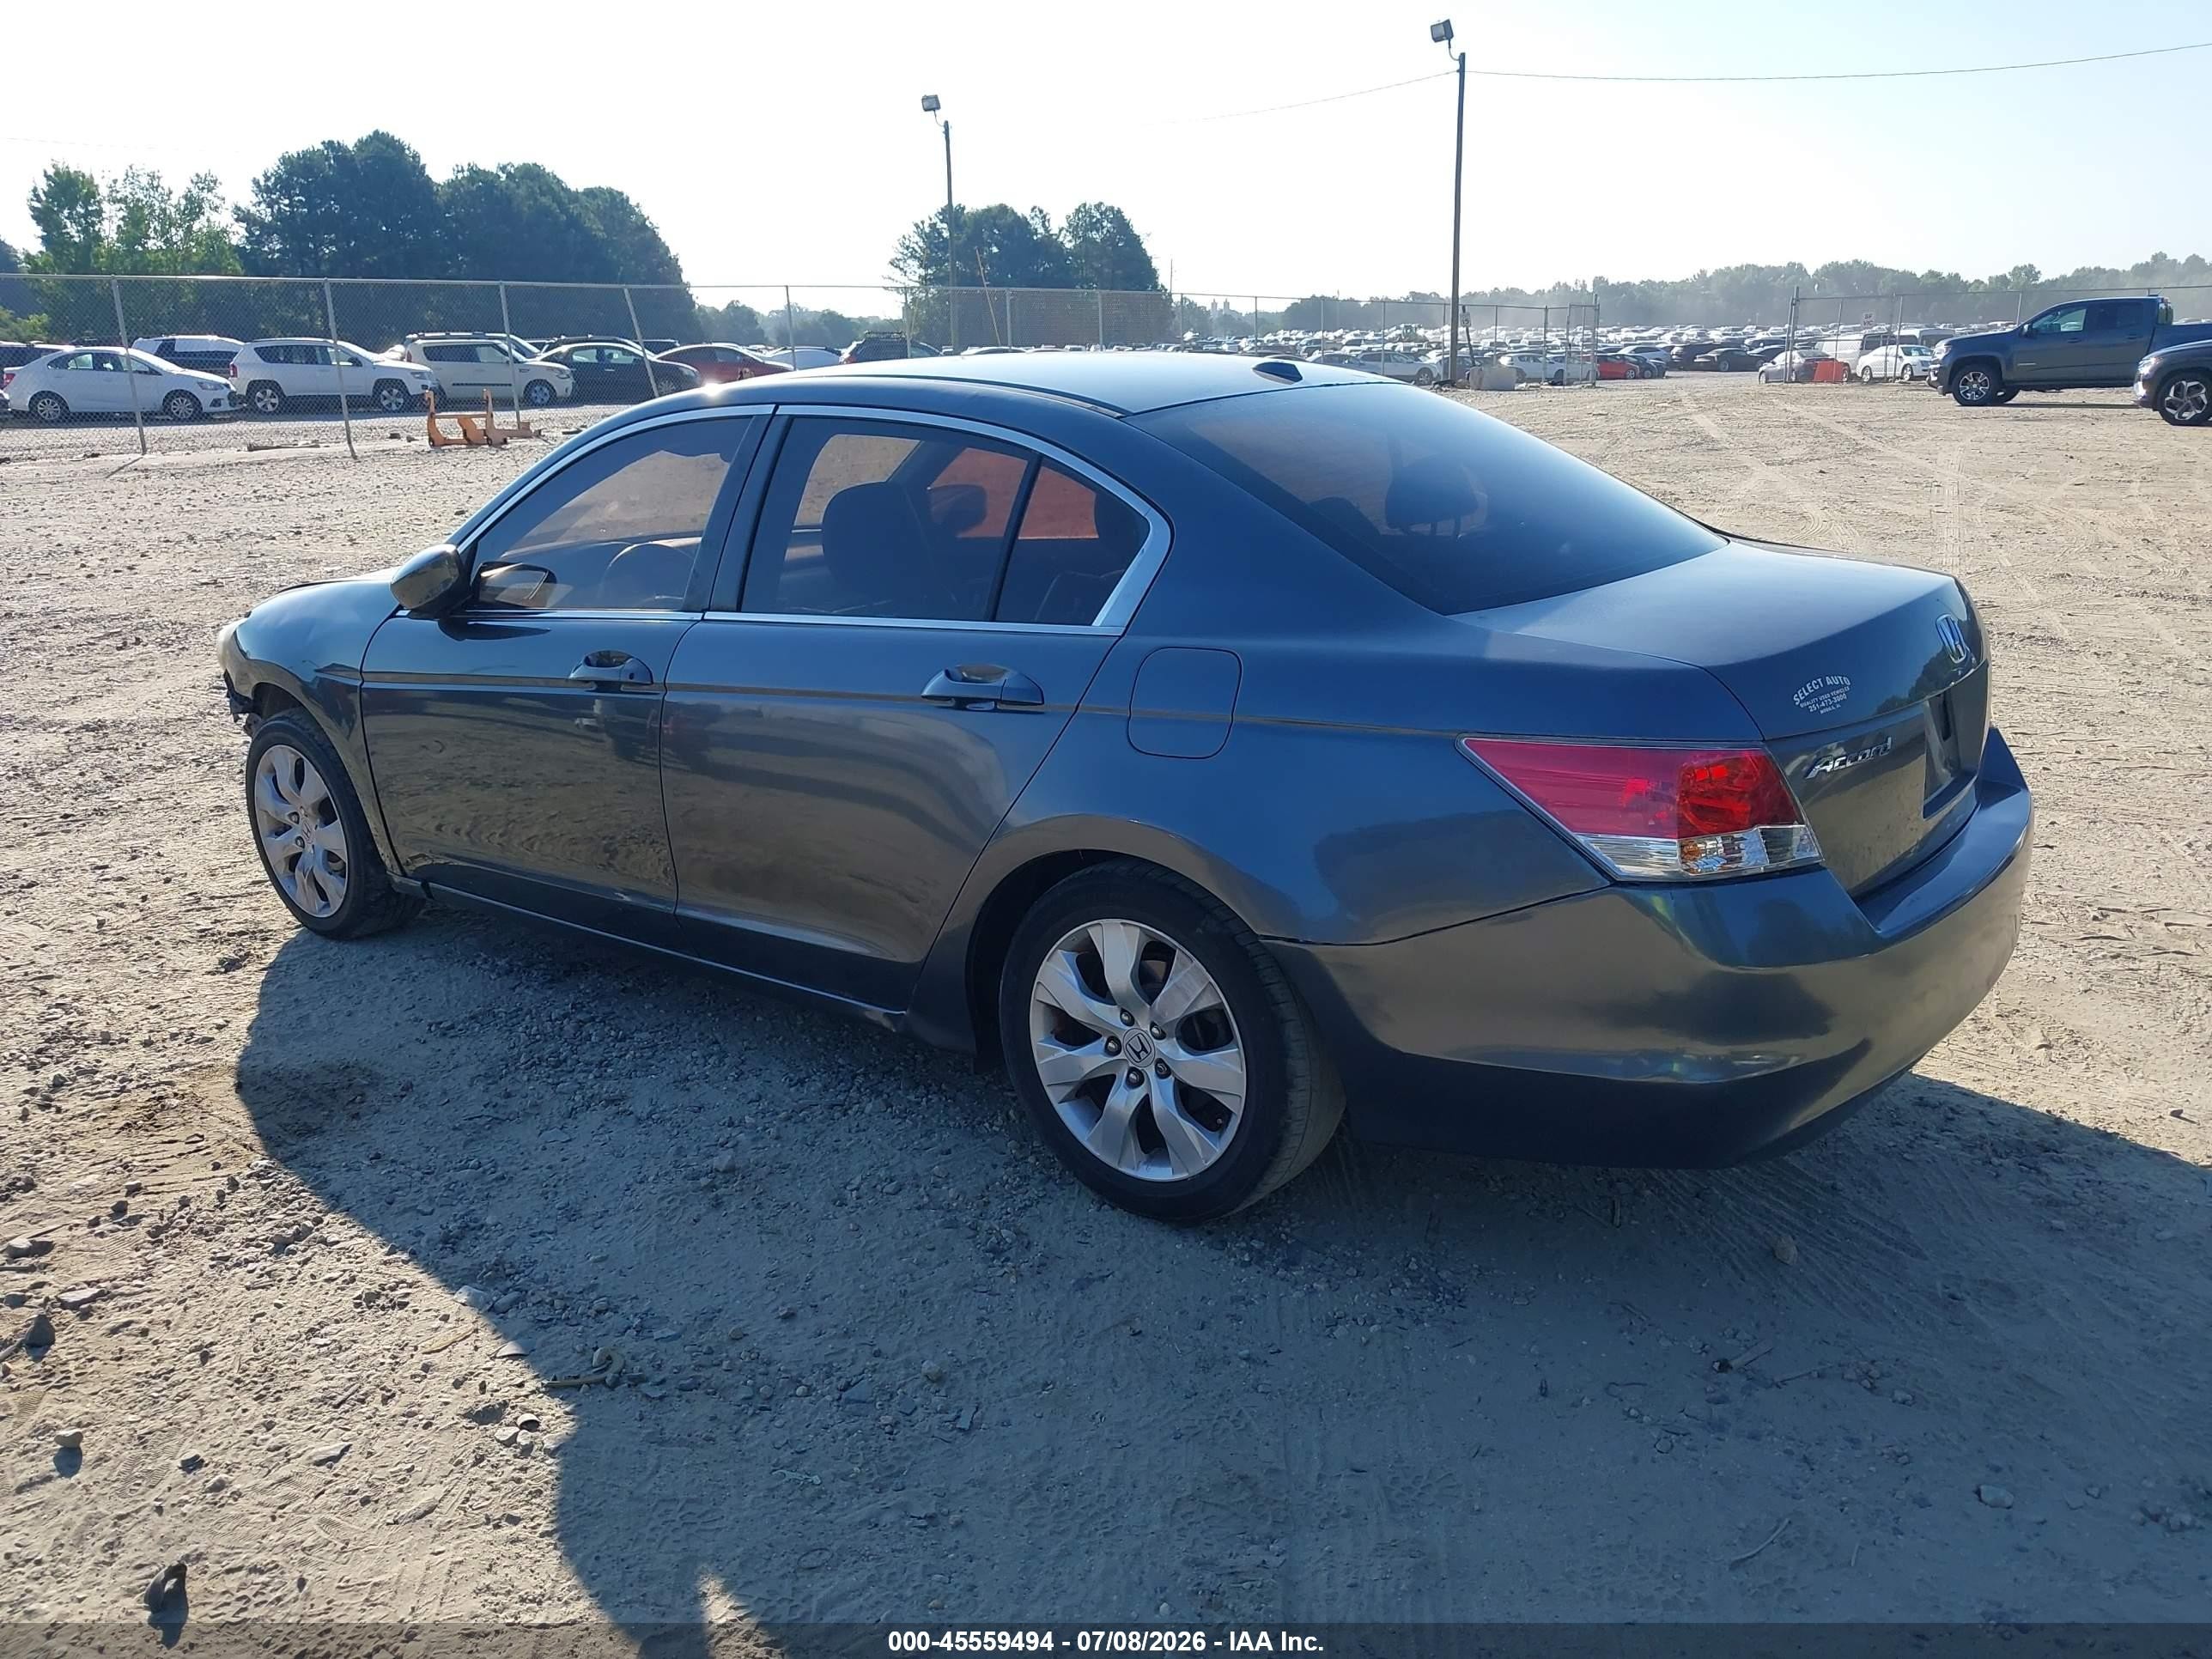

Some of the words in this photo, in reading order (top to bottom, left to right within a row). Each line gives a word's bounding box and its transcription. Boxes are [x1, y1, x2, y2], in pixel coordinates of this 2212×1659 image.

[1793, 678, 1824, 706] SELECT
[1826, 675, 1850, 686] AUTO
[1808, 693, 1847, 713] 251-473-3000
[1805, 737, 1893, 780] Accord
